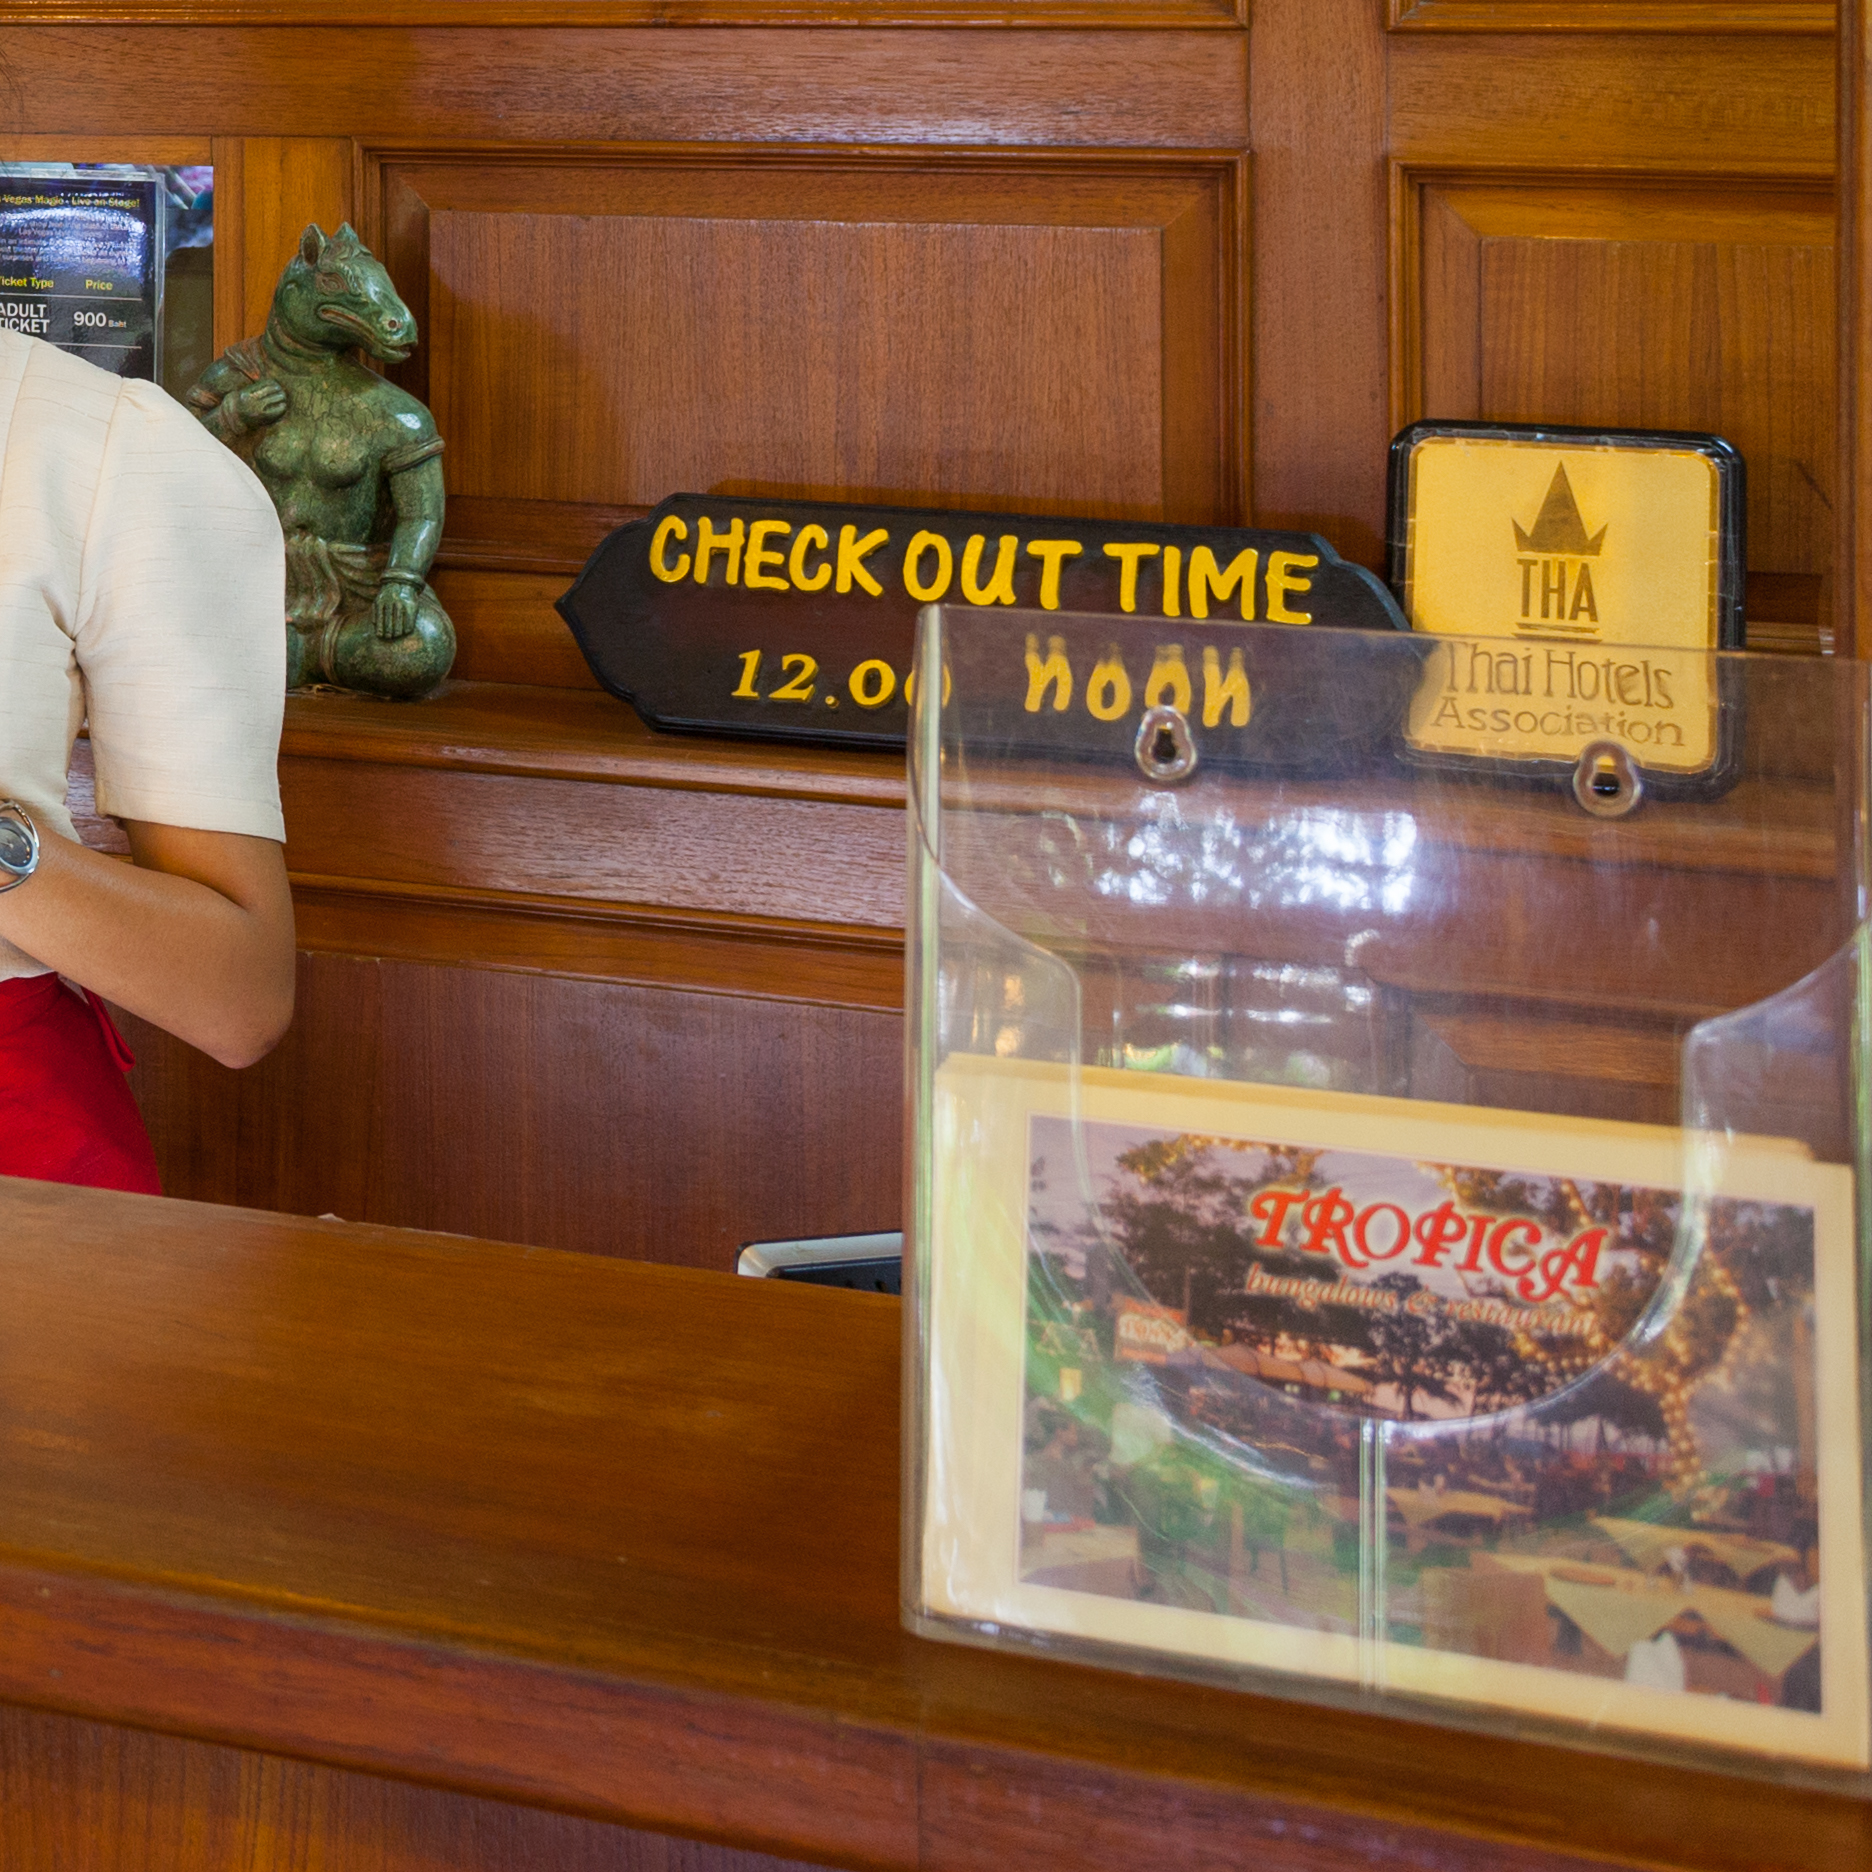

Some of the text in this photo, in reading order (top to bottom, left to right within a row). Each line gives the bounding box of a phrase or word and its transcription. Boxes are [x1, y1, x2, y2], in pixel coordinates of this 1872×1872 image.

[3, 194, 32, 205] Vegas
[35, 194, 64, 206] Magic
[72, 196, 91, 206] Live
[93, 198, 106, 206] on
[108, 197, 140, 208] Stage!
[30, 277, 54, 290] Type
[85, 279, 113, 290] Price
[73, 311, 107, 328] 900
[109, 320, 126, 328] Baht
[649, 514, 1319, 625] CHECK OUT TIME
[1517, 558, 1599, 622] THA
[1024, 633, 1252, 727] noon
[1446, 640, 1674, 709] Thai Hotels
[1430, 695, 1686, 747] Association
[1249, 1187, 1608, 1303] TROPICA
[1246, 1263, 1599, 1334] bungalows & restaurant
